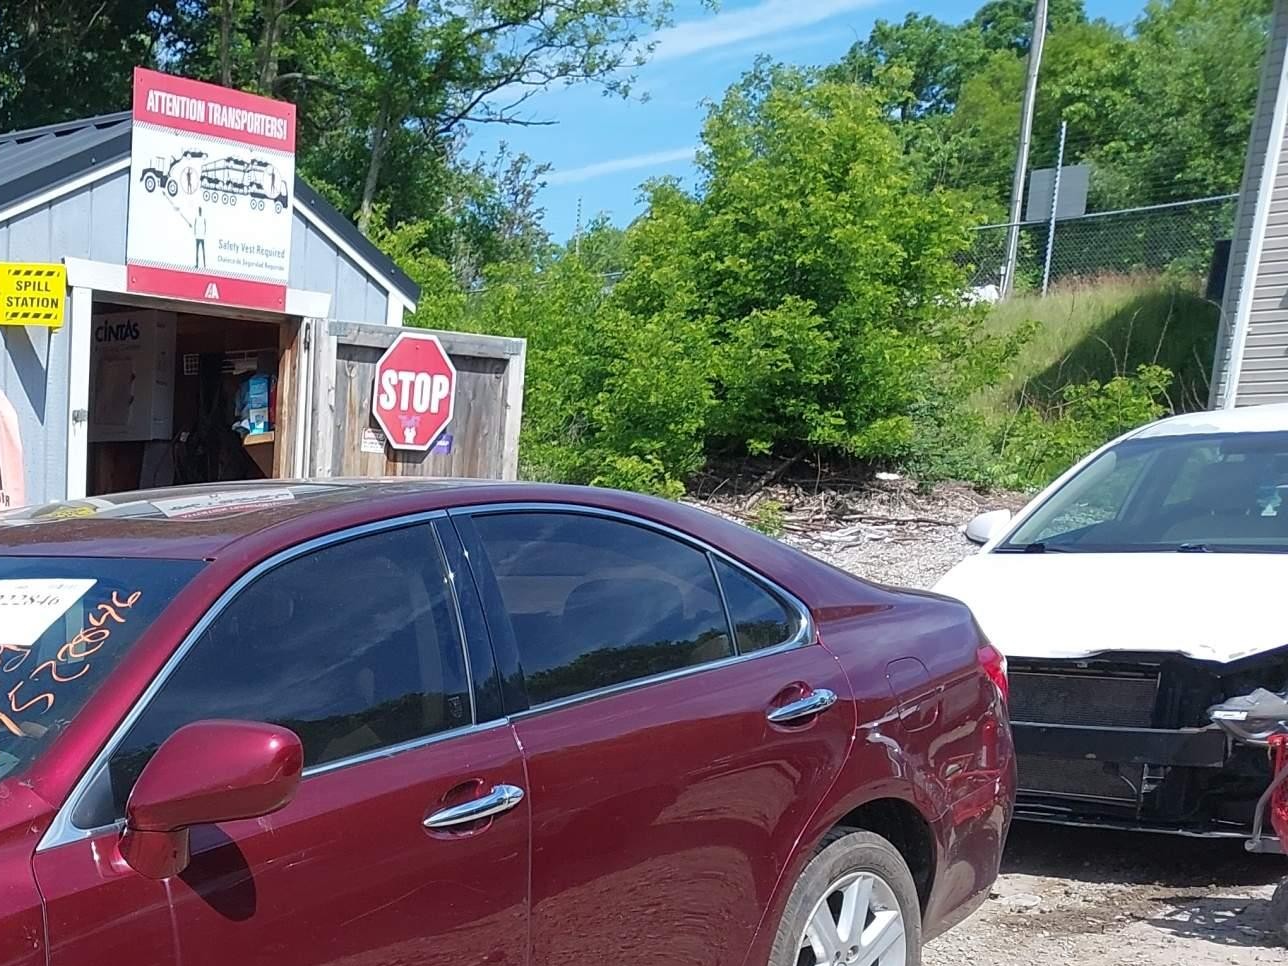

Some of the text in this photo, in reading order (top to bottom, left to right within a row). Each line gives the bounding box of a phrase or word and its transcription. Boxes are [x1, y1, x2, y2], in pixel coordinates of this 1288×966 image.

[146, 89, 288, 140] ATTENTION TRANSPORTERS!
[15, 280, 52, 293] SPILL
[6, 296, 59, 309] STATION
[95, 319, 140, 342] CINTAS
[379, 369, 450, 414] STOP
